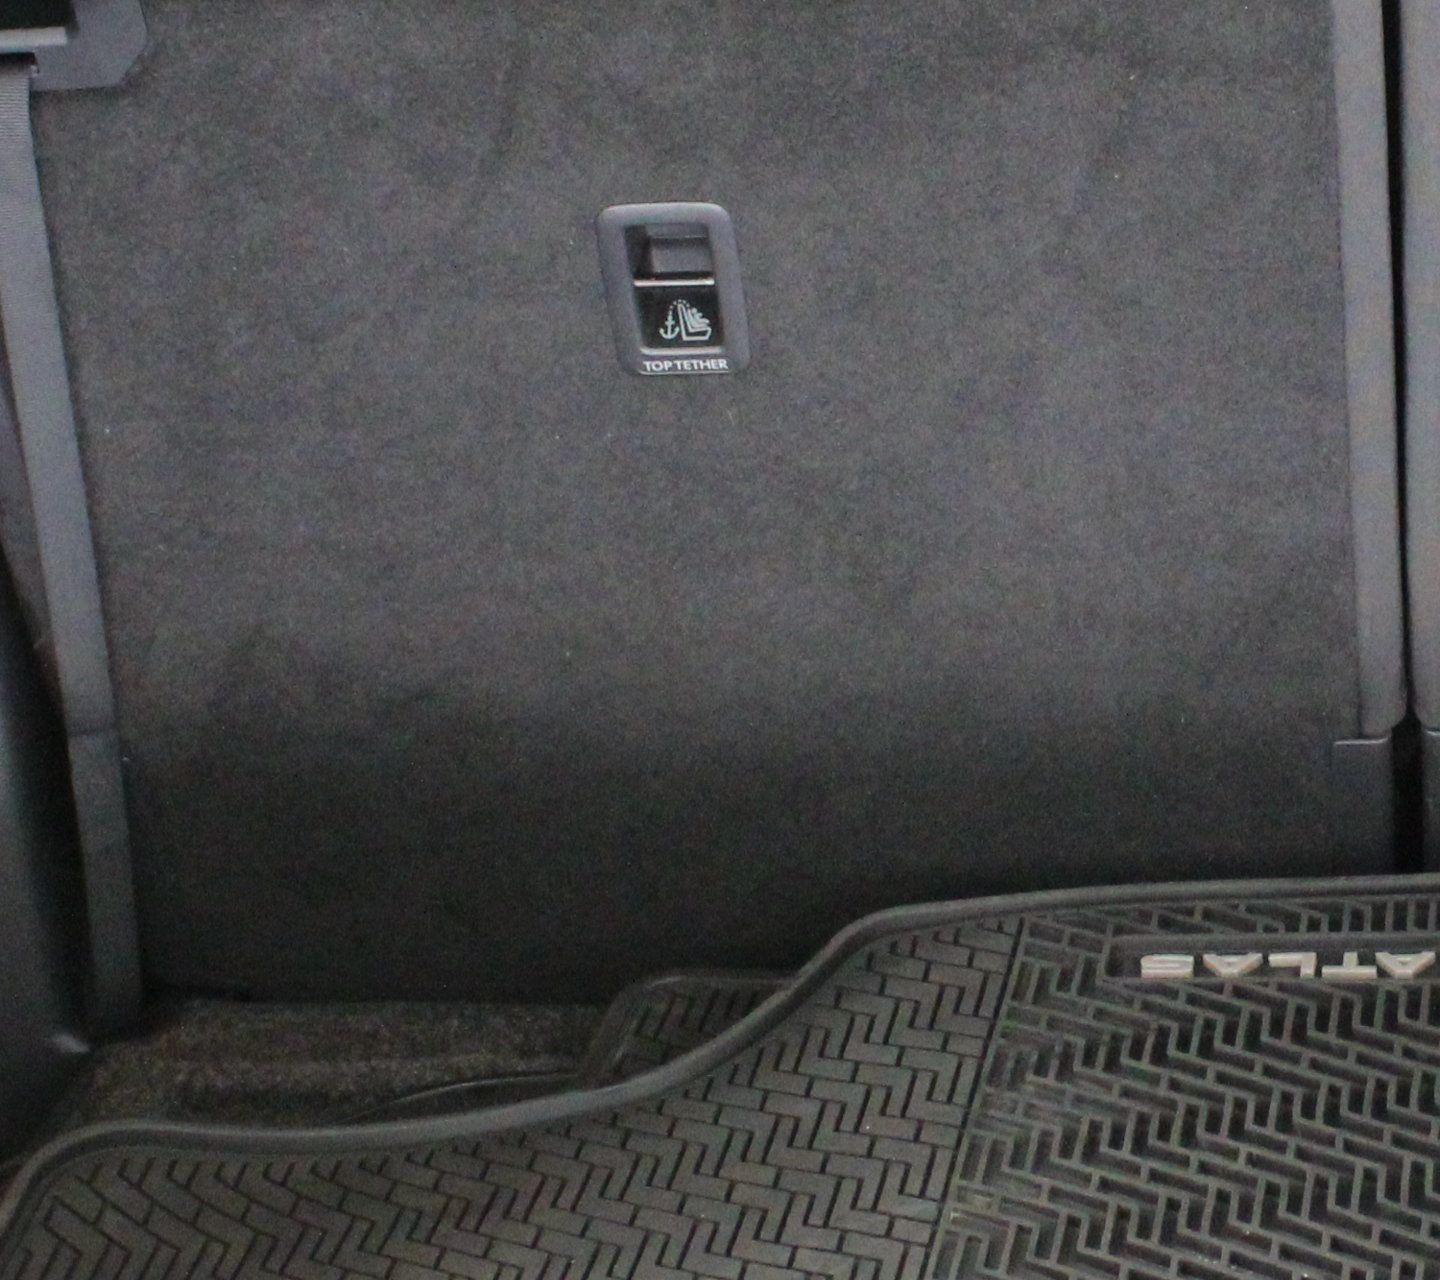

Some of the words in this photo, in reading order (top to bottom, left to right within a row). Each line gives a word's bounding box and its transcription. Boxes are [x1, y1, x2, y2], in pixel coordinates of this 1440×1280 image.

[642, 360, 672, 372] TOP
[673, 359, 729, 371] TETHER
[1140, 951, 1436, 979] ATLAS
